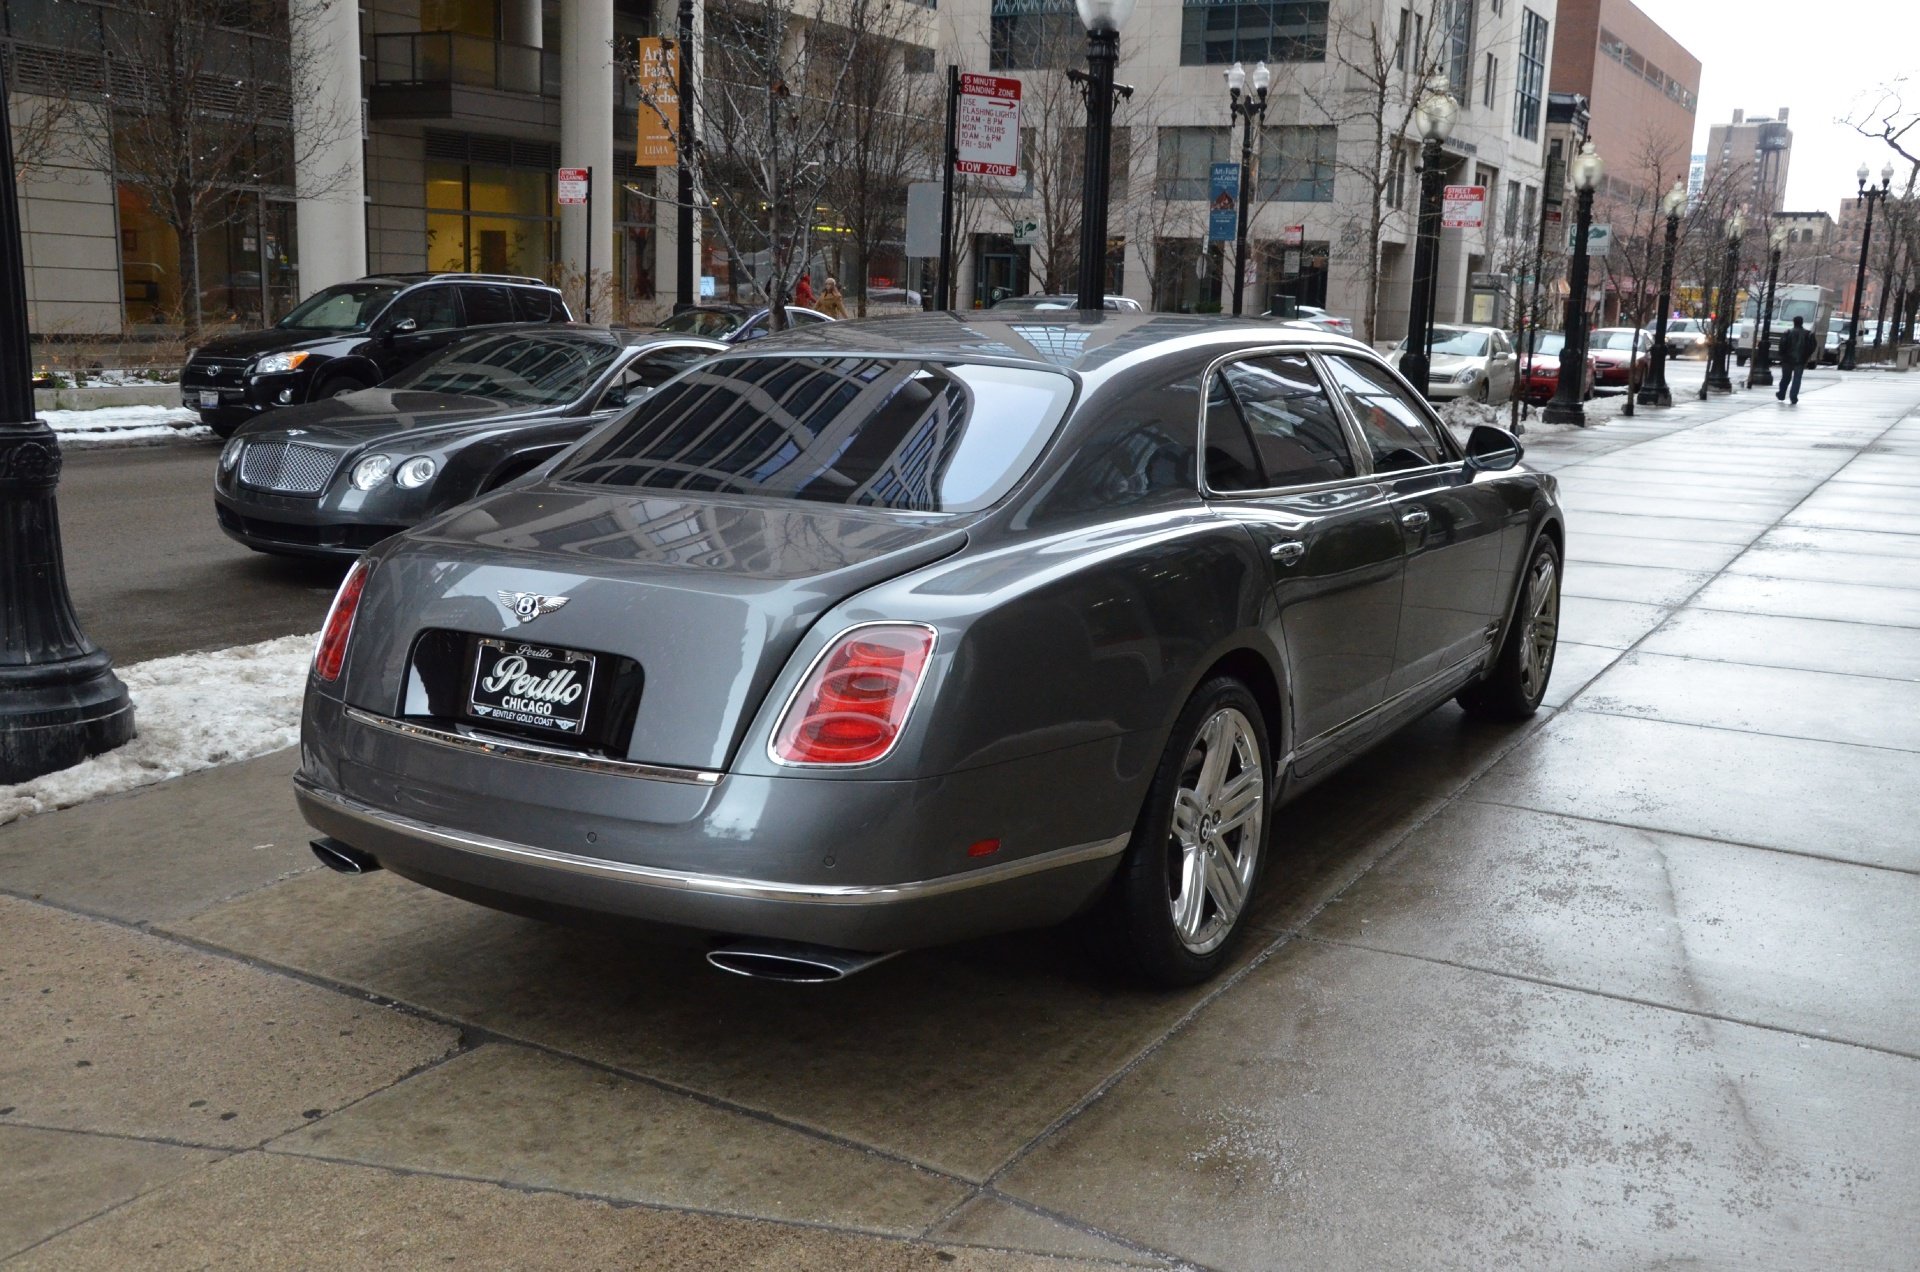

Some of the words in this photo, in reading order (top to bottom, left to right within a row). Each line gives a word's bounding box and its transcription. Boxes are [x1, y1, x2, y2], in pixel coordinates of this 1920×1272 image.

[964, 75, 971, 84] 15
[973, 77, 997, 87] MINUTE
[964, 84, 995, 96] STANDING
[998, 88, 1015, 98] ZONE
[963, 98, 976, 106] USE
[962, 106, 994, 117] FLASHING
[994, 109, 1017, 120] LIGHTS
[962, 114, 970, 122] 10
[970, 115, 981, 124] AM
[986, 117, 992, 125] 8
[993, 117, 1003, 125] PM
[961, 123, 977, 131] MON
[984, 125, 1006, 135] THURS
[961, 131, 969, 139] 10
[969, 132, 980, 140] AM
[986, 134, 990, 142] 6
[991, 134, 1002, 142] PM
[645, 145, 669, 155] LUMA
[961, 139, 972, 148] FRI
[978, 141, 992, 150] SUN
[960, 161, 981, 172] TOW
[985, 164, 1012, 176] ZONE
[1447, 187, 1471, 195] STREET
[515, 644, 553, 659] Perillo
[482, 655, 582, 706] Perillo
[501, 695, 552, 716] CHICAGO
[492, 709, 517, 720] BENTLEY
[516, 713, 533, 724] GOLD
[534, 716, 554, 727] COAST
